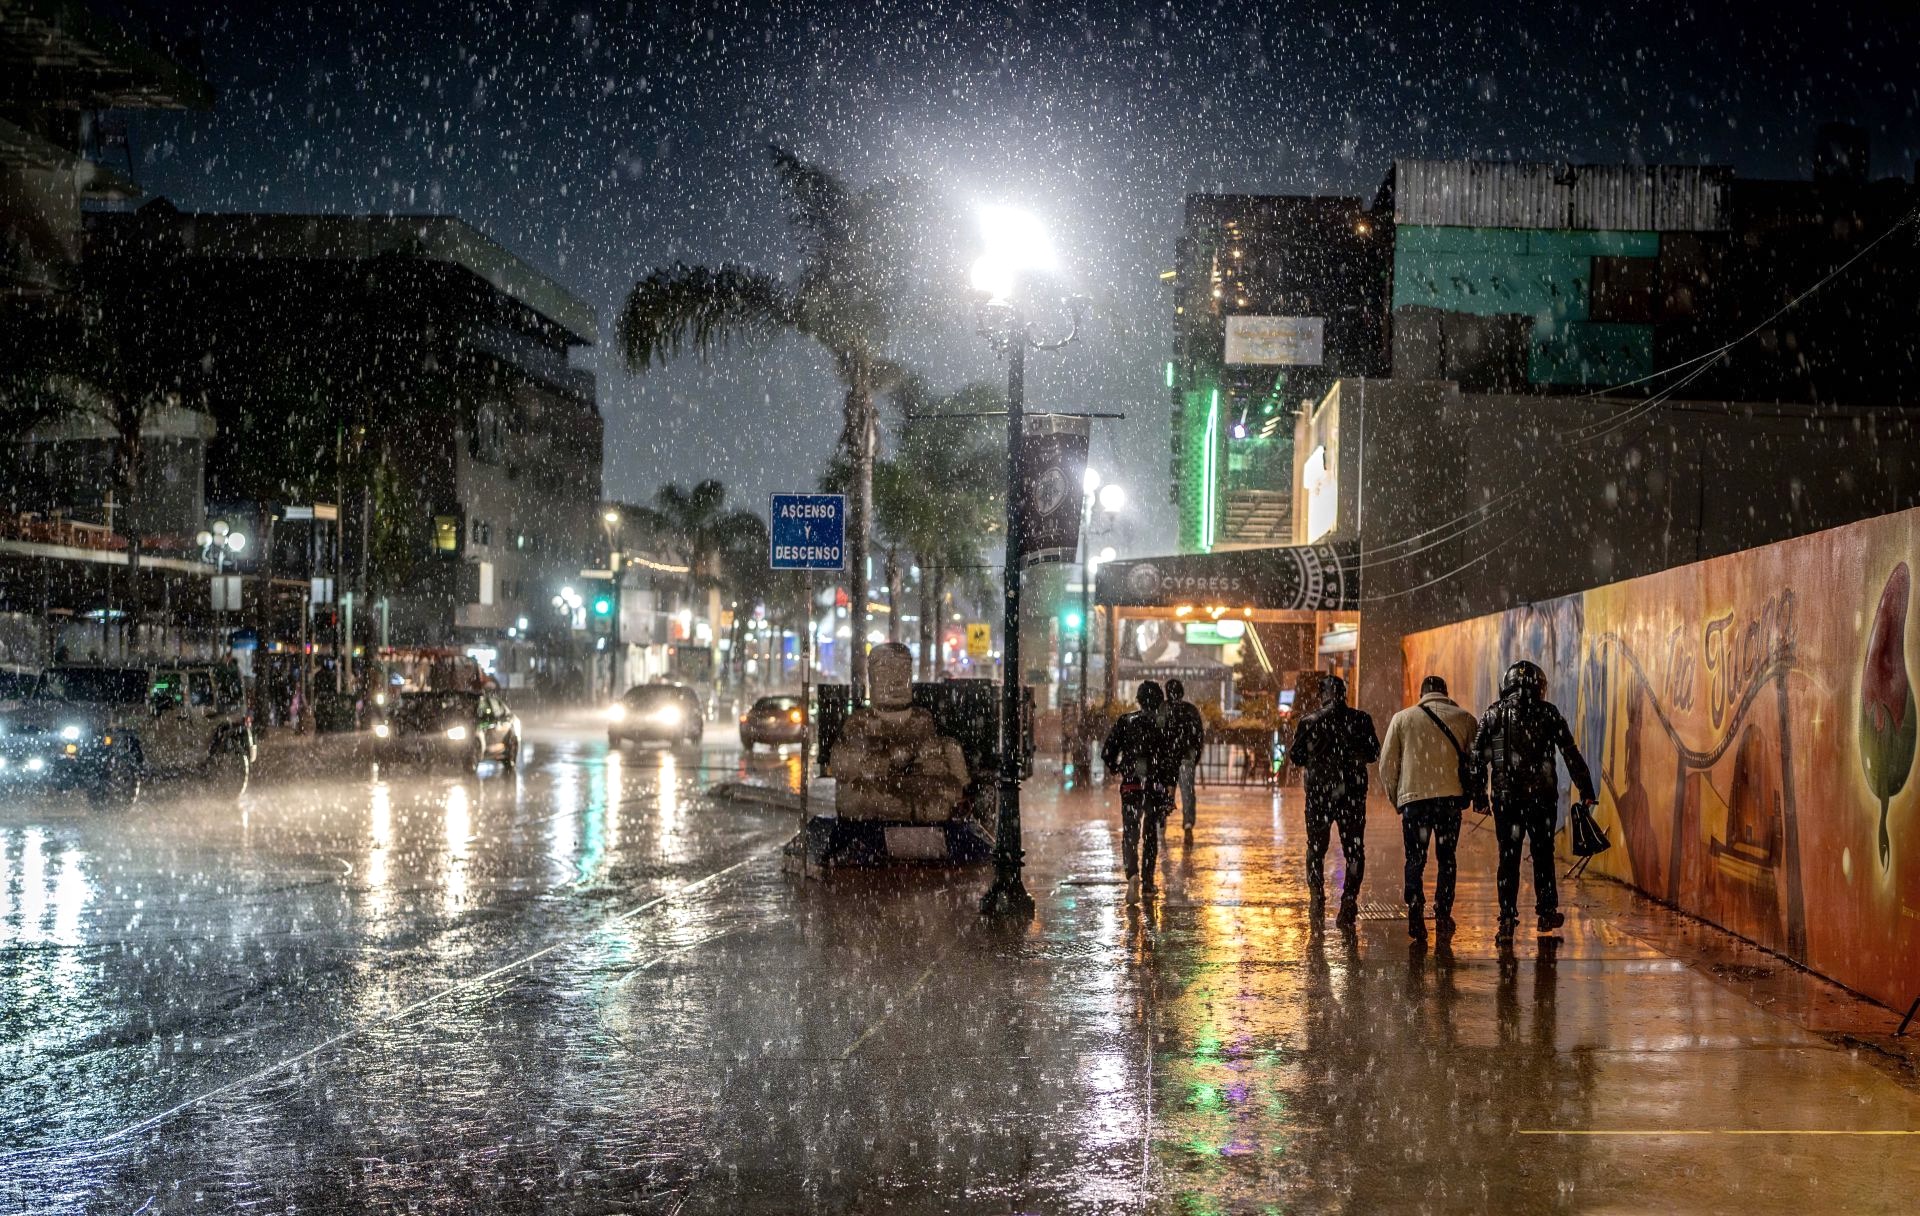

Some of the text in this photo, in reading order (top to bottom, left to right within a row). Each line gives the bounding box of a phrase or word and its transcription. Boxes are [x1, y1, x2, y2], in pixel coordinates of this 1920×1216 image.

[781, 505, 835, 518] ASCENSO
[804, 526, 812, 539] Y
[775, 546, 840, 560] DESCENSO
[1162, 577, 1240, 591] CYPRESS
